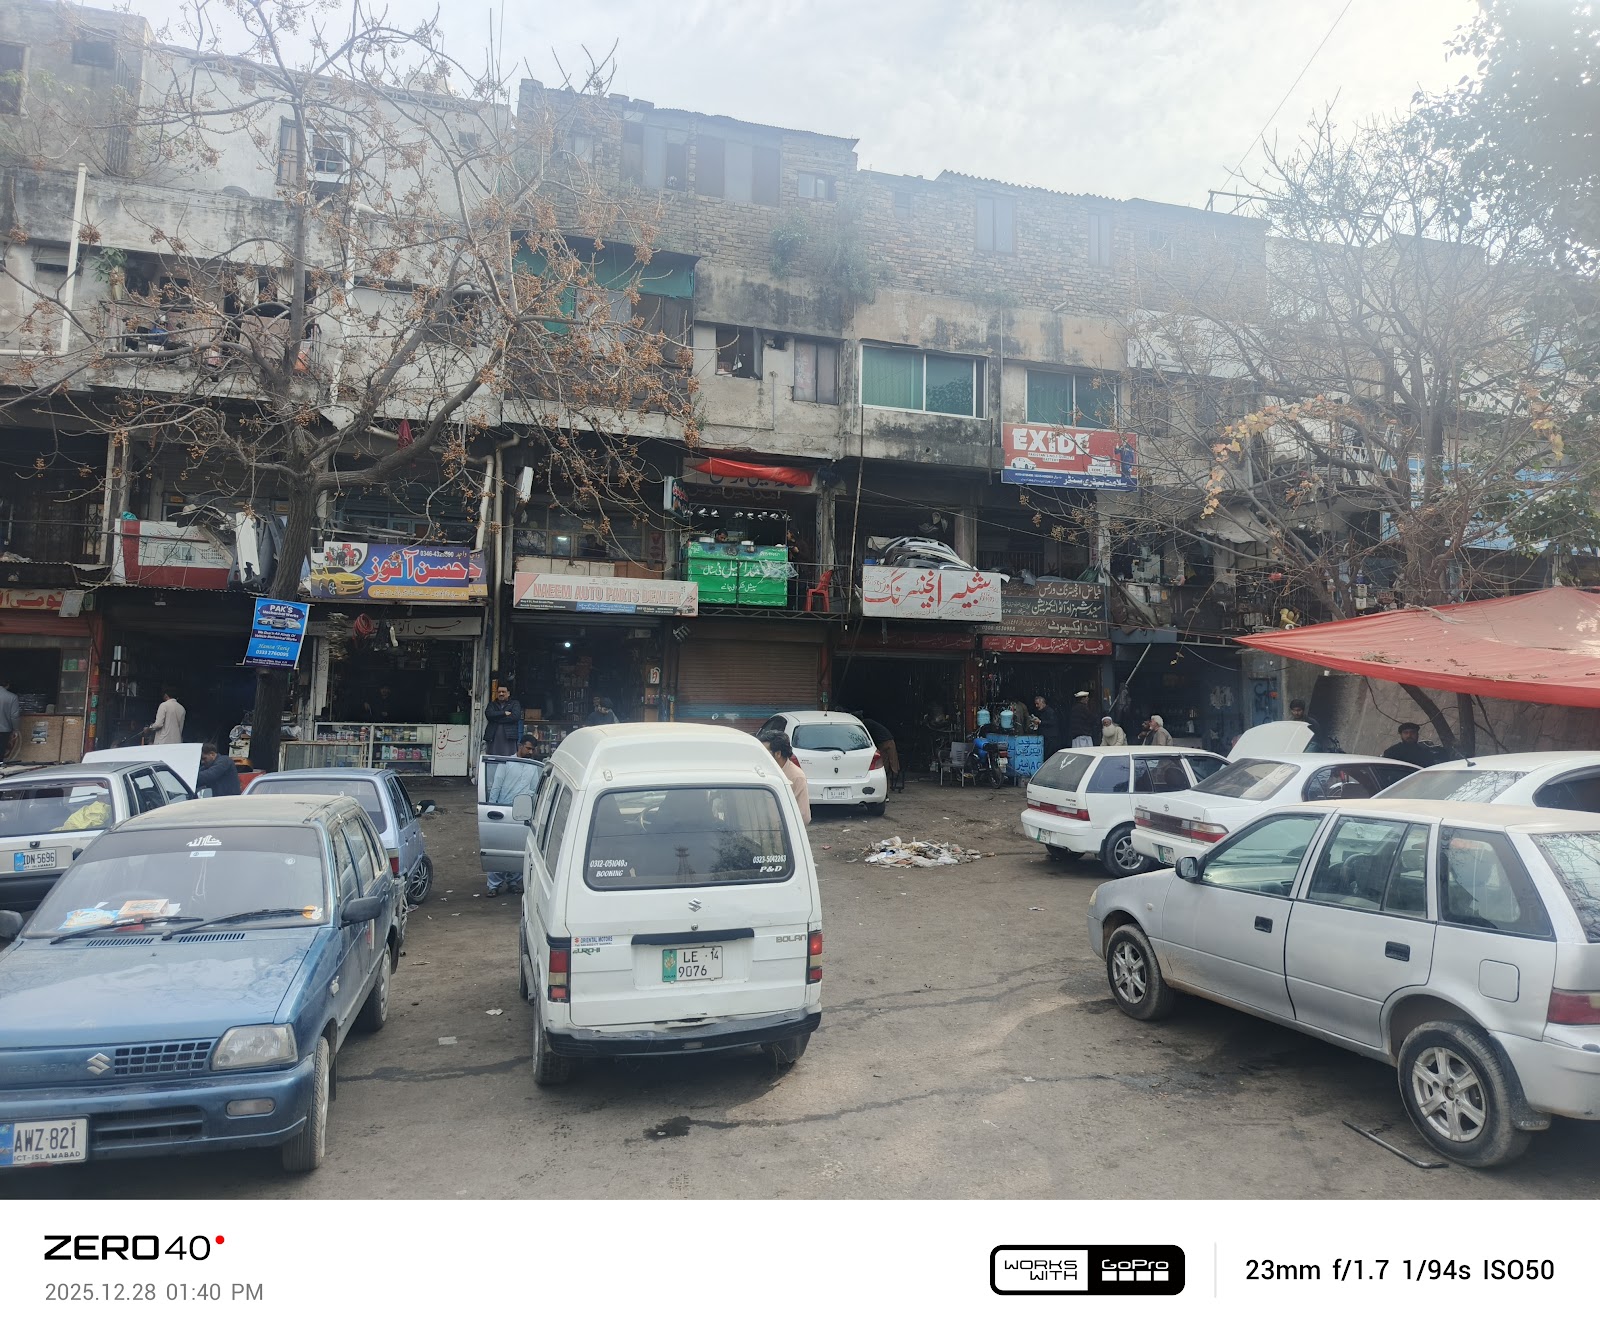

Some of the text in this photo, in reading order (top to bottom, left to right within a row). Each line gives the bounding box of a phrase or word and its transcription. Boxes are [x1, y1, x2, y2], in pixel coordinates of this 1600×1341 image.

[1012, 428, 1094, 454] EXIDE
[414, 562, 468, 584] حسن
[533, 583, 572, 599] NAEEM
[575, 585, 603, 601] AUTO
[606, 587, 640, 603] PARTS
[641, 589, 681, 605] DEALER
[270, 604, 293, 613] PAK'S
[776, 934, 806, 943] BOLAN
[684, 951, 718, 963] LE 14
[679, 965, 707, 977] 9076
[14, 1151, 80, 1161] ICT-ISLAMABAD
